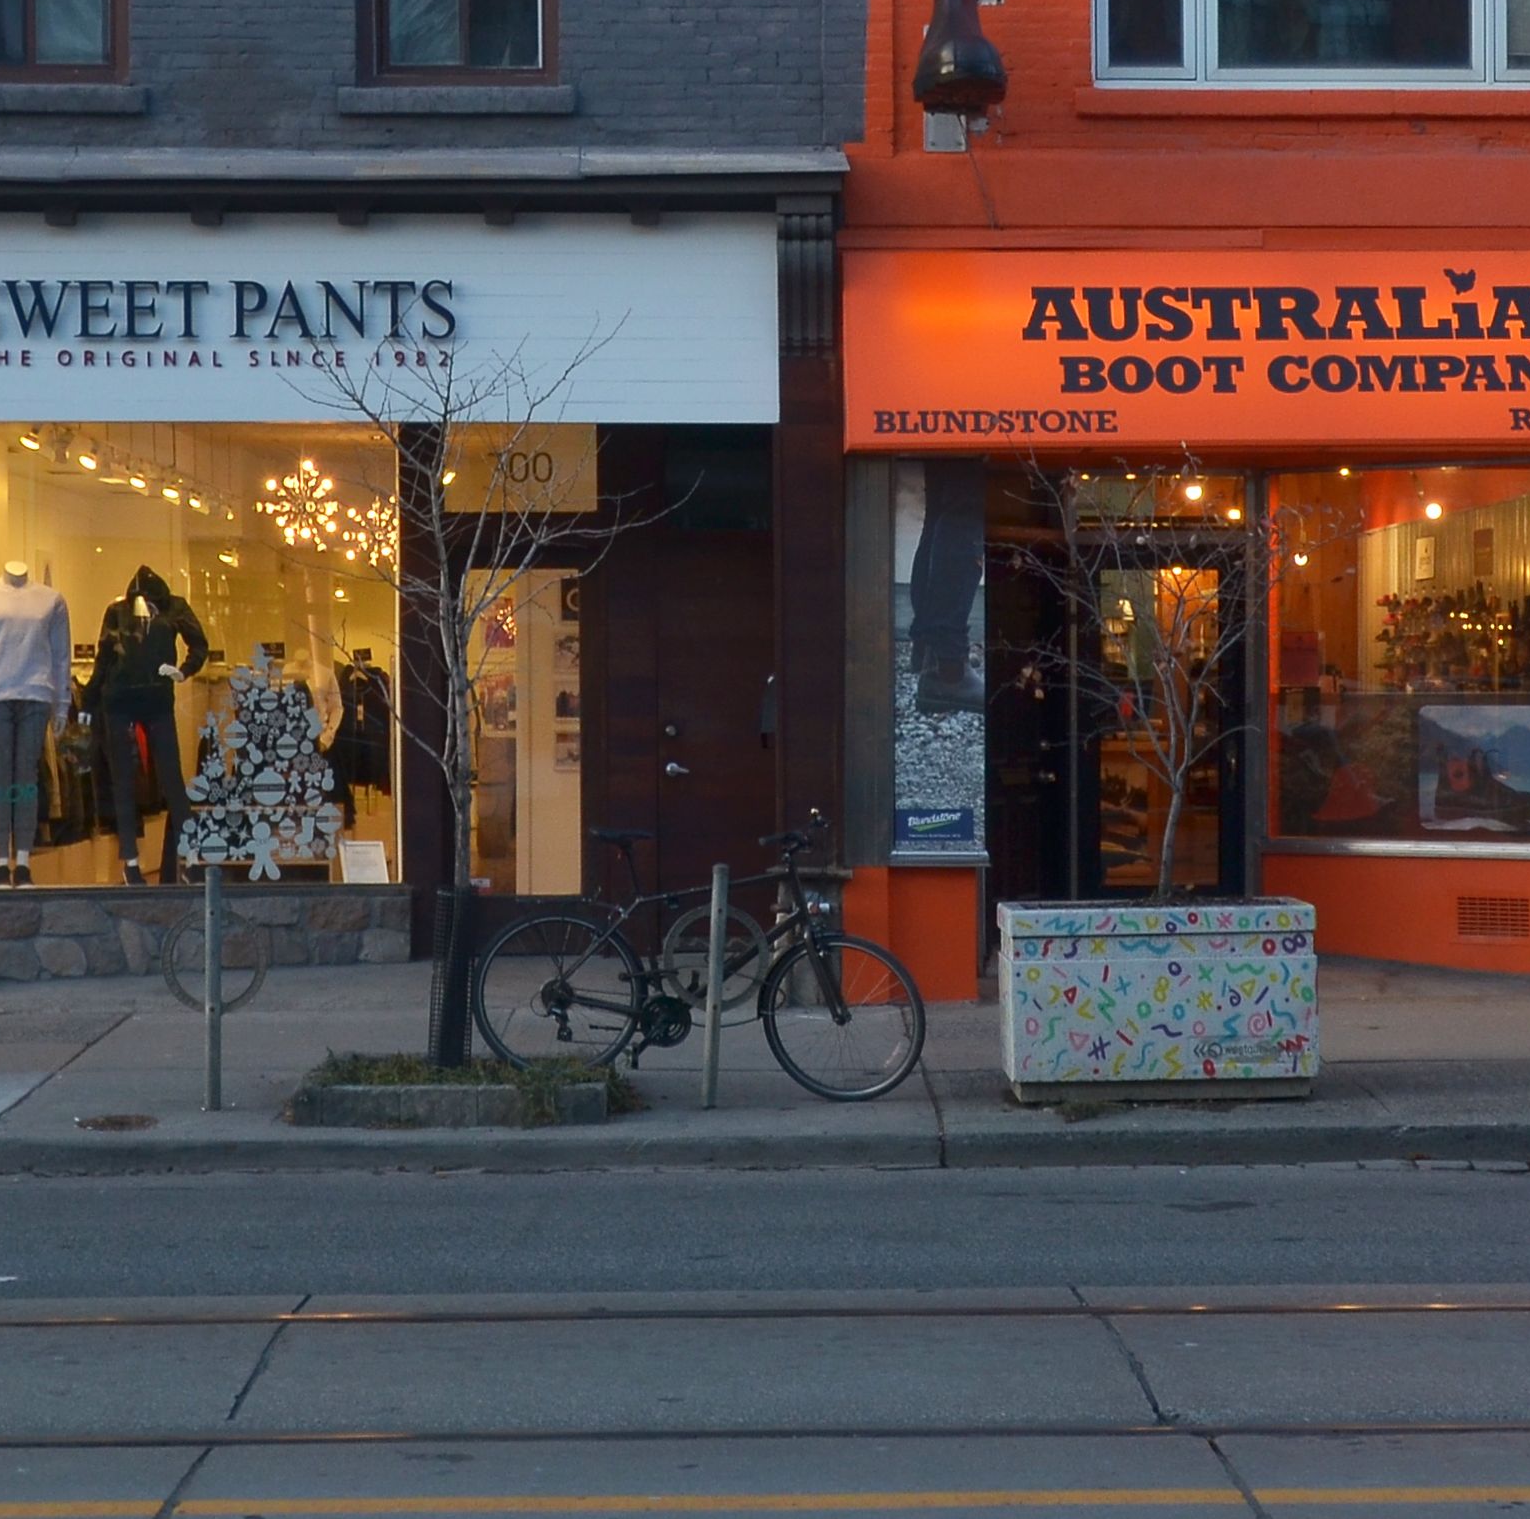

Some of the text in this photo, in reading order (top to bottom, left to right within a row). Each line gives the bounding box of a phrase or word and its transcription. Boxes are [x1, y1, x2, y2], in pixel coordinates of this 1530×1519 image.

[229, 278, 458, 340] PANTS
[57, 349, 223, 368] ORIGINAL
[249, 349, 347, 368] SINCE
[373, 349, 451, 368] 1982
[1060, 354, 1245, 394] BOOT
[873, 409, 1119, 434] BLUNDSTONE
